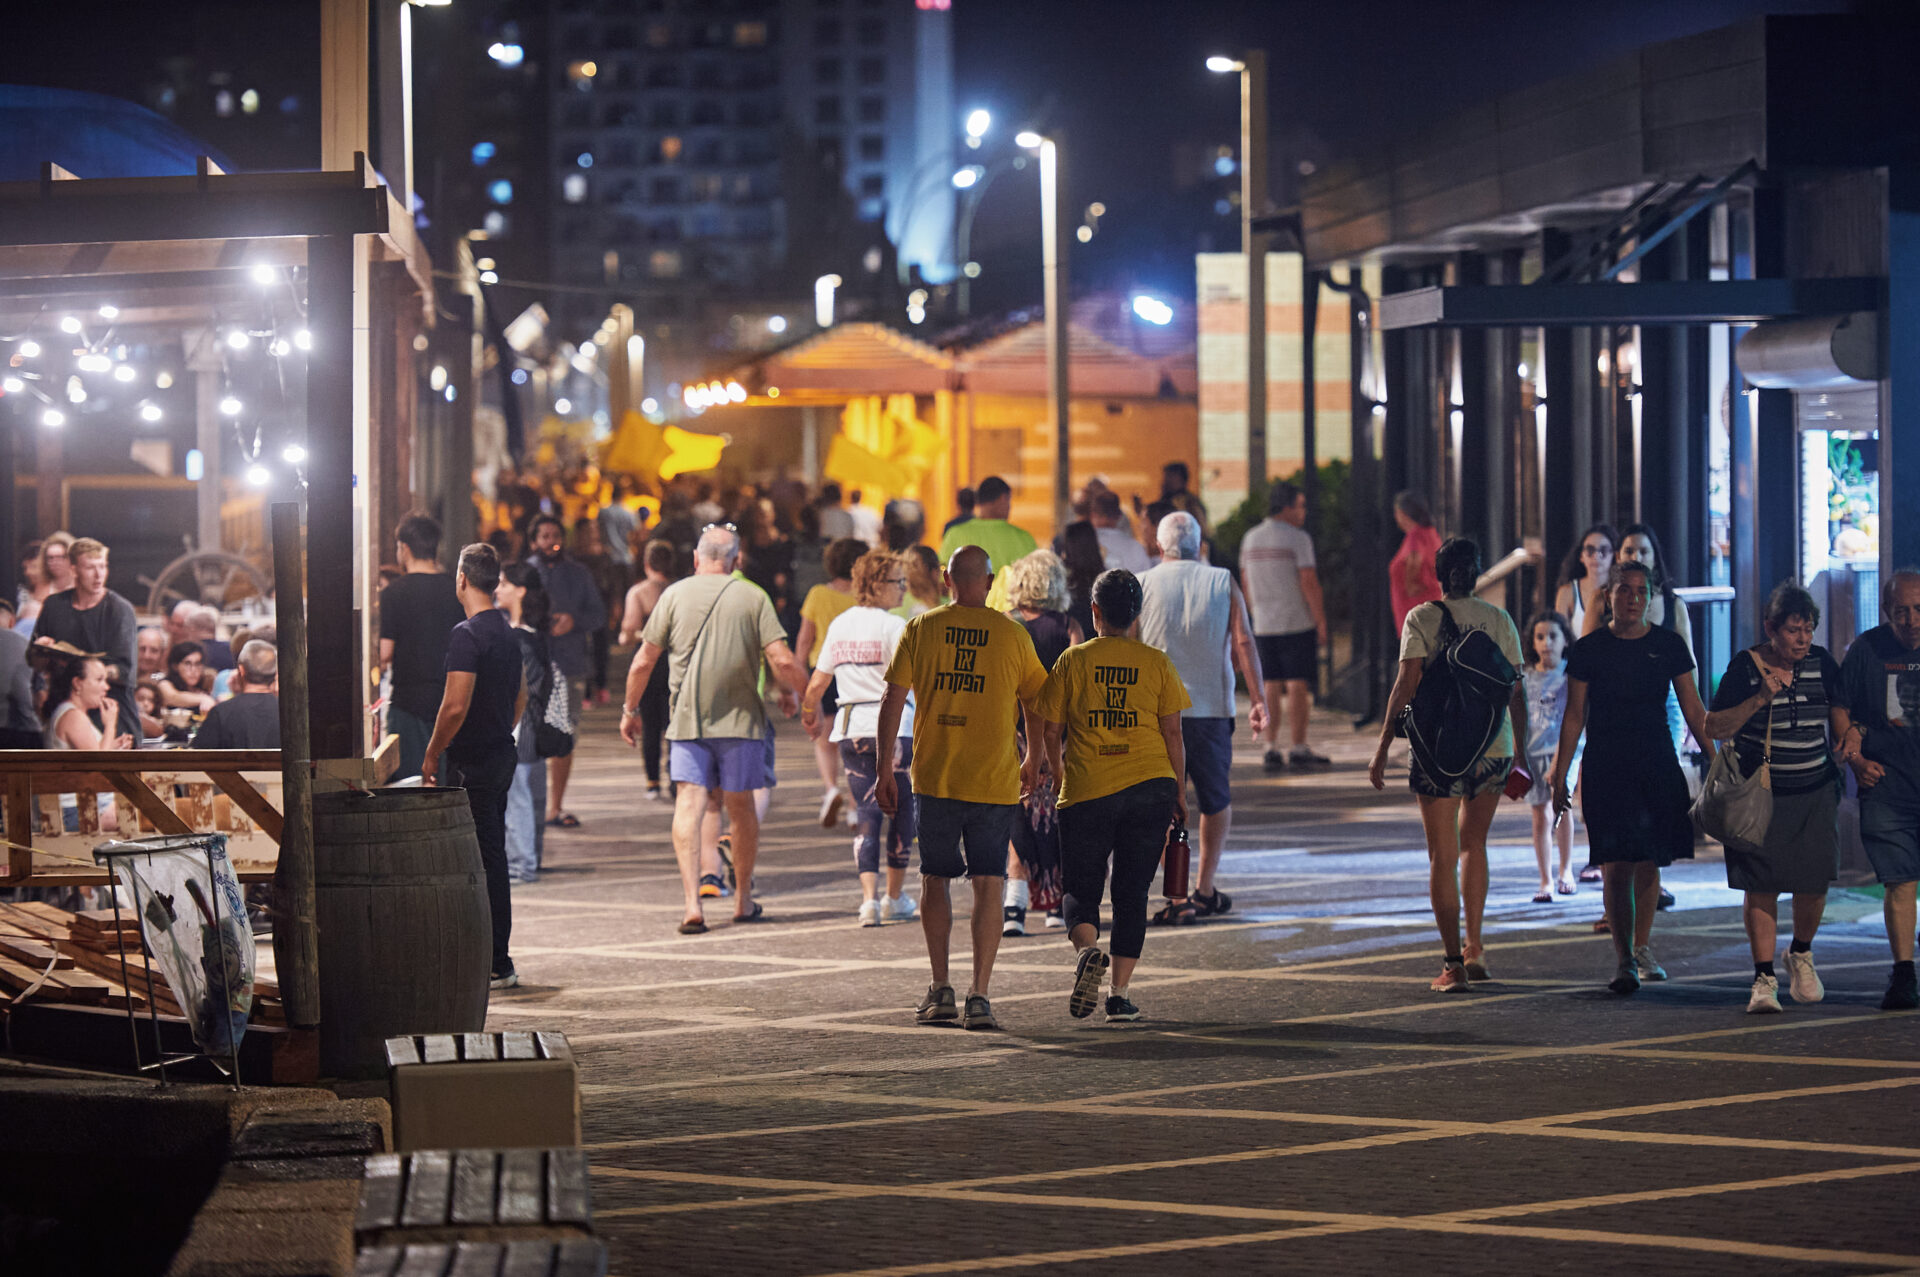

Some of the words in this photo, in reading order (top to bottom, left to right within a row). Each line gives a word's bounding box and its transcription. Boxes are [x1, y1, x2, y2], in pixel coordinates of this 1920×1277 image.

[945, 626, 989, 648] עסקה
[956, 649, 975, 671] או
[934, 672, 985, 694] הפקרה
[1095, 665, 1139, 686] עסקה
[1107, 688, 1126, 709] או
[1088, 709, 1138, 730] הפקרה
